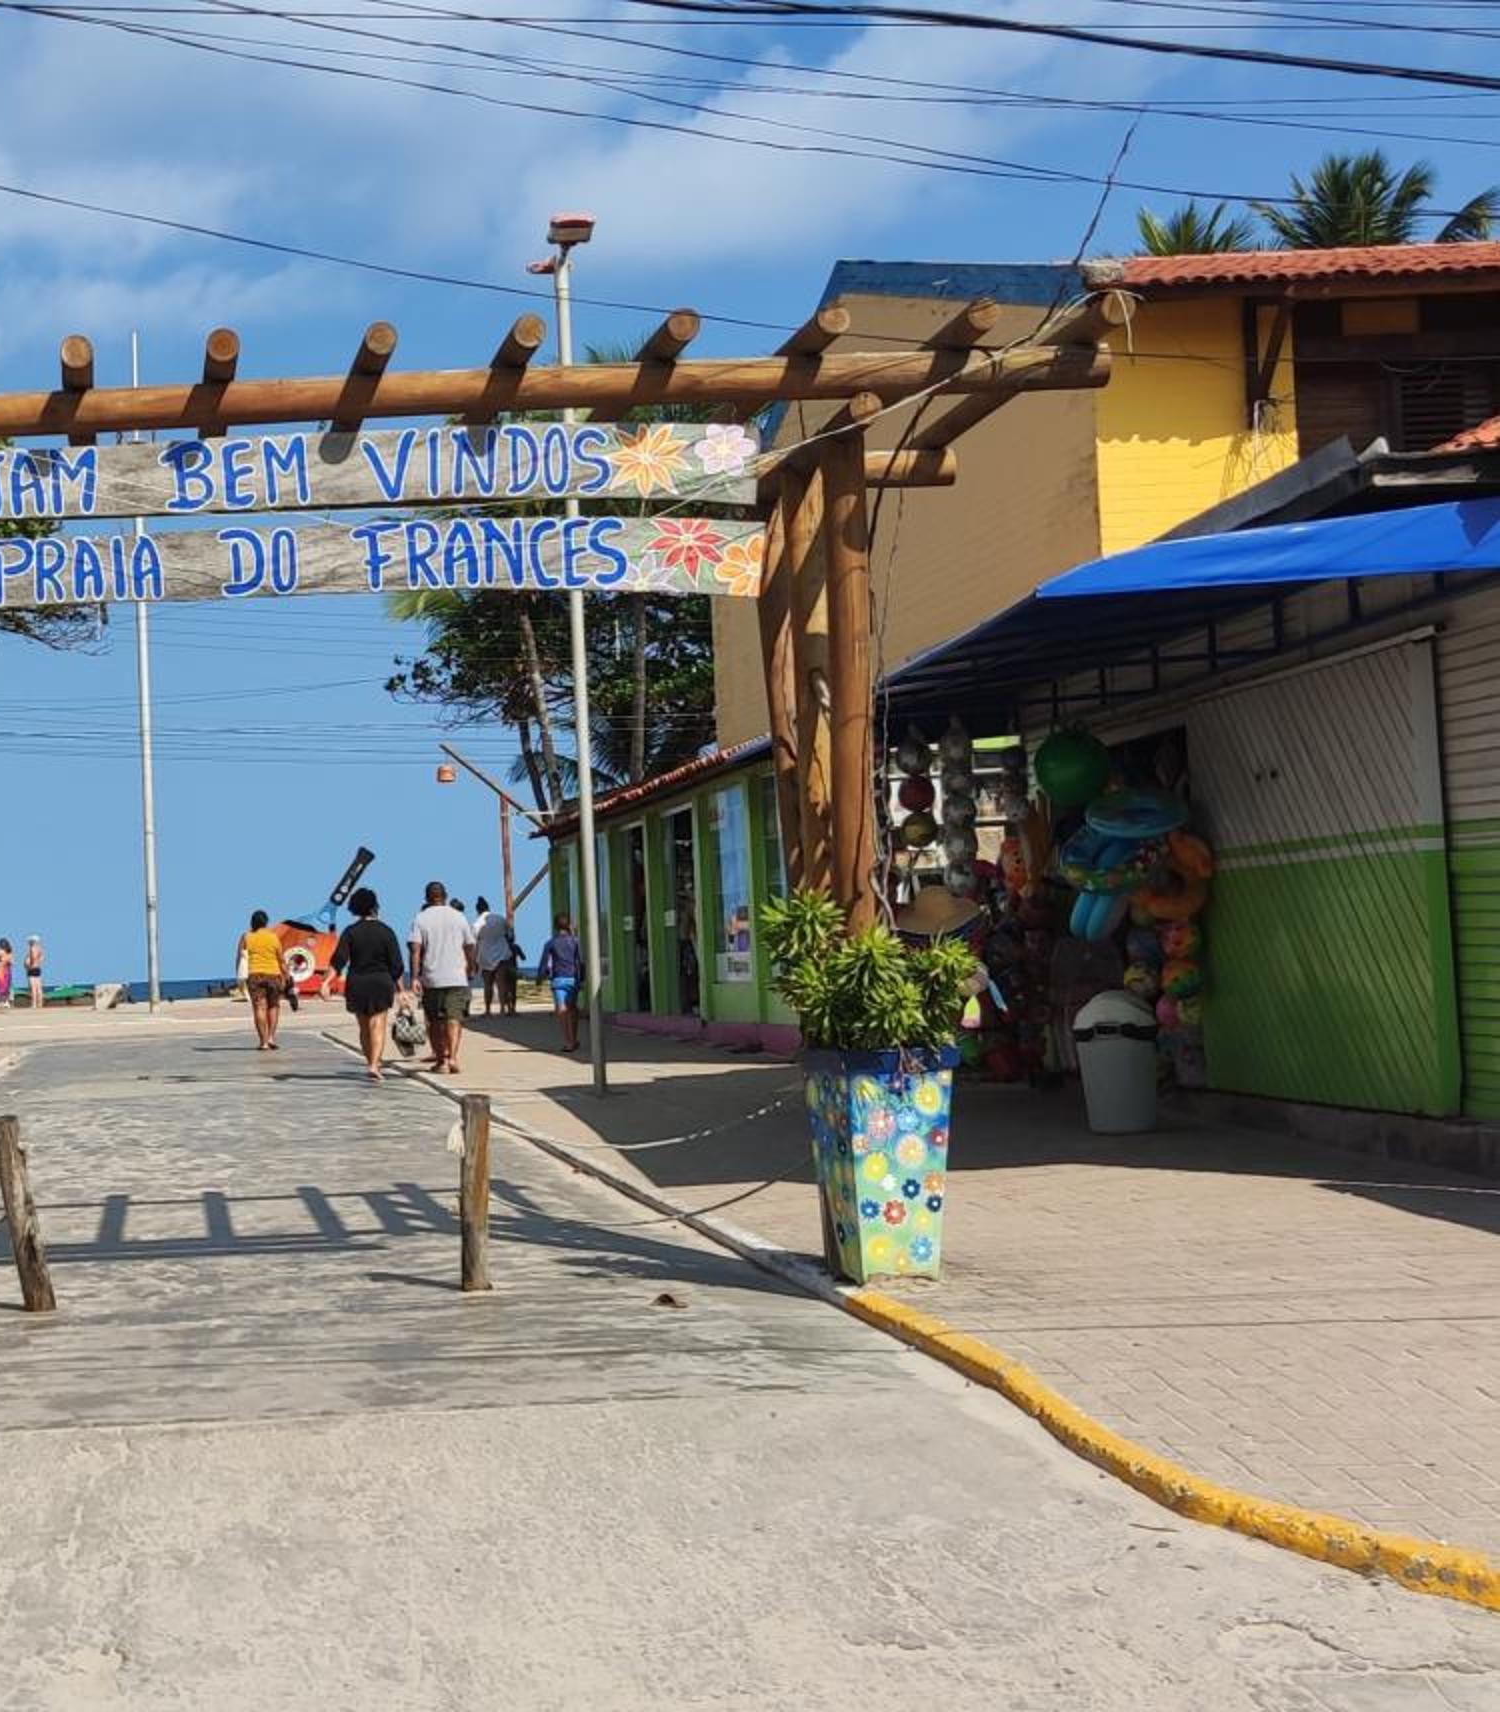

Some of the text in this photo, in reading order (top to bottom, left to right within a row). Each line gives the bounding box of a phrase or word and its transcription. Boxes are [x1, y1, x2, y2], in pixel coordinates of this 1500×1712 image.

[158, 432, 312, 513] BEM
[361, 427, 613, 501] VINDOS
[218, 527, 299, 597] DO
[351, 518, 628, 592] FRANCES
